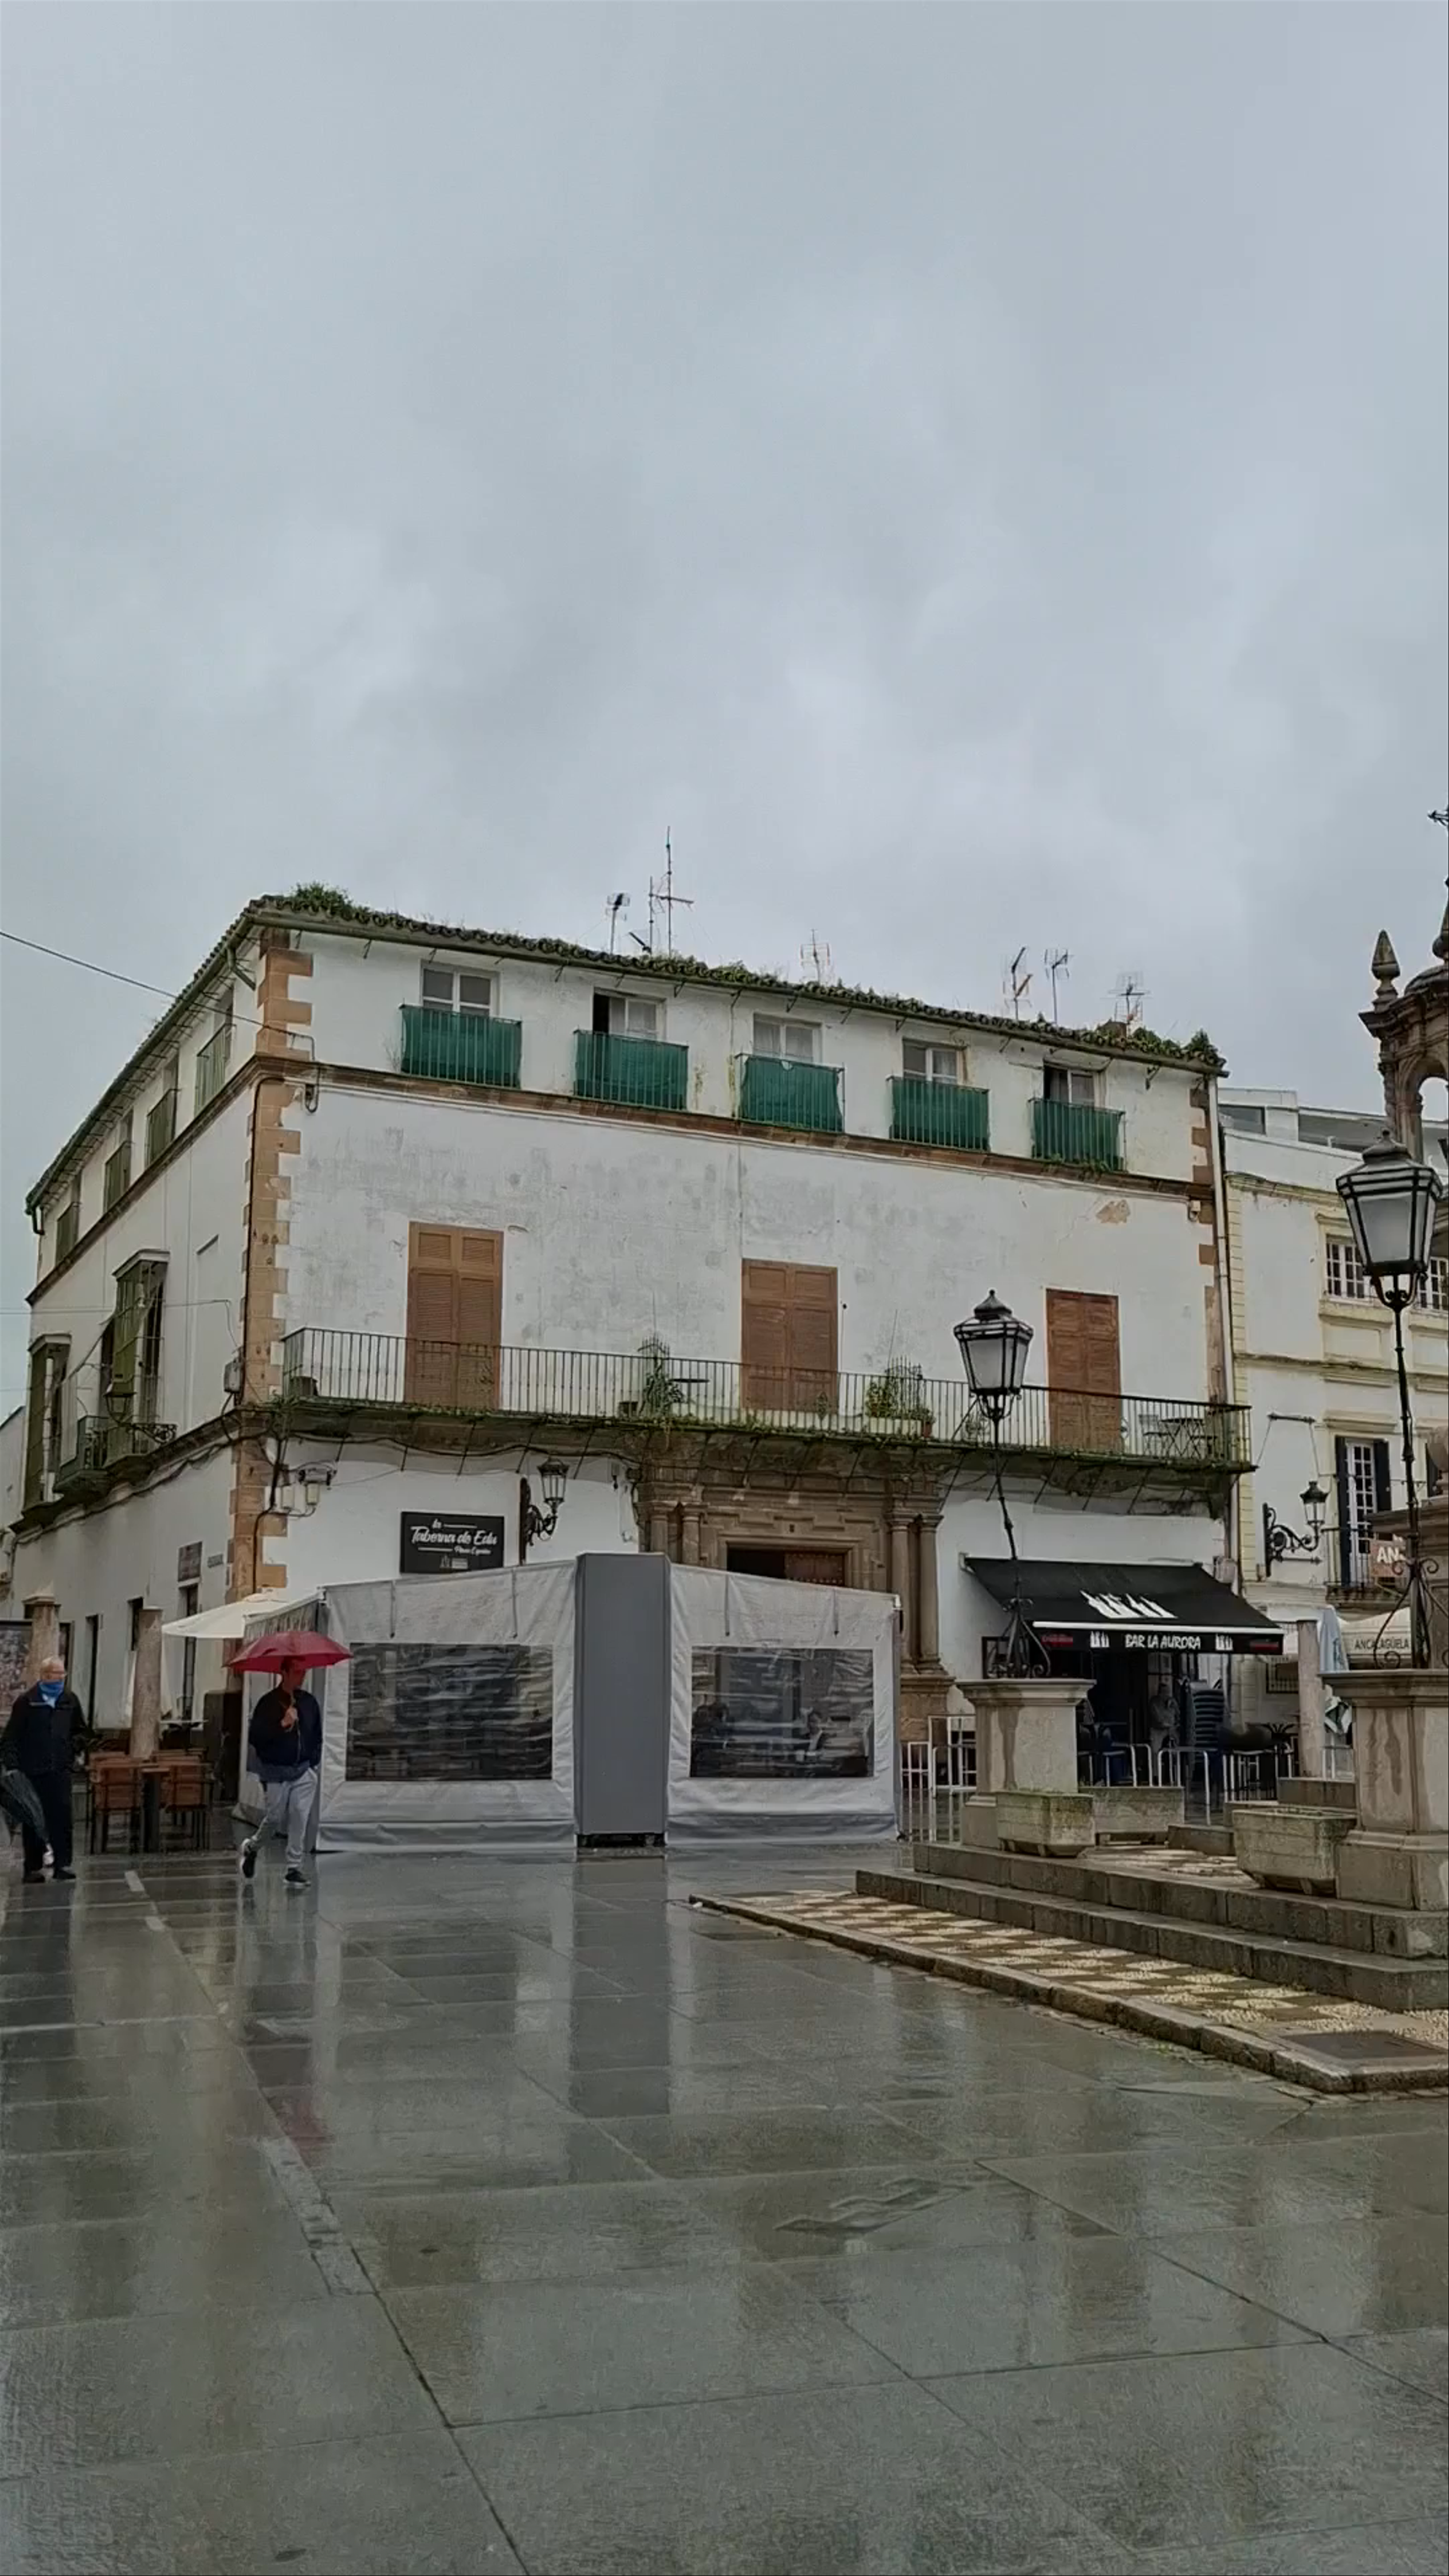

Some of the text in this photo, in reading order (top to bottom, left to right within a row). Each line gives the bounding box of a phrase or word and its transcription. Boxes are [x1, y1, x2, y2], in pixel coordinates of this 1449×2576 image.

[410, 1526, 497, 1545] Taberna de Edu
[1125, 1633, 1201, 1650] BAR LA AURORA
